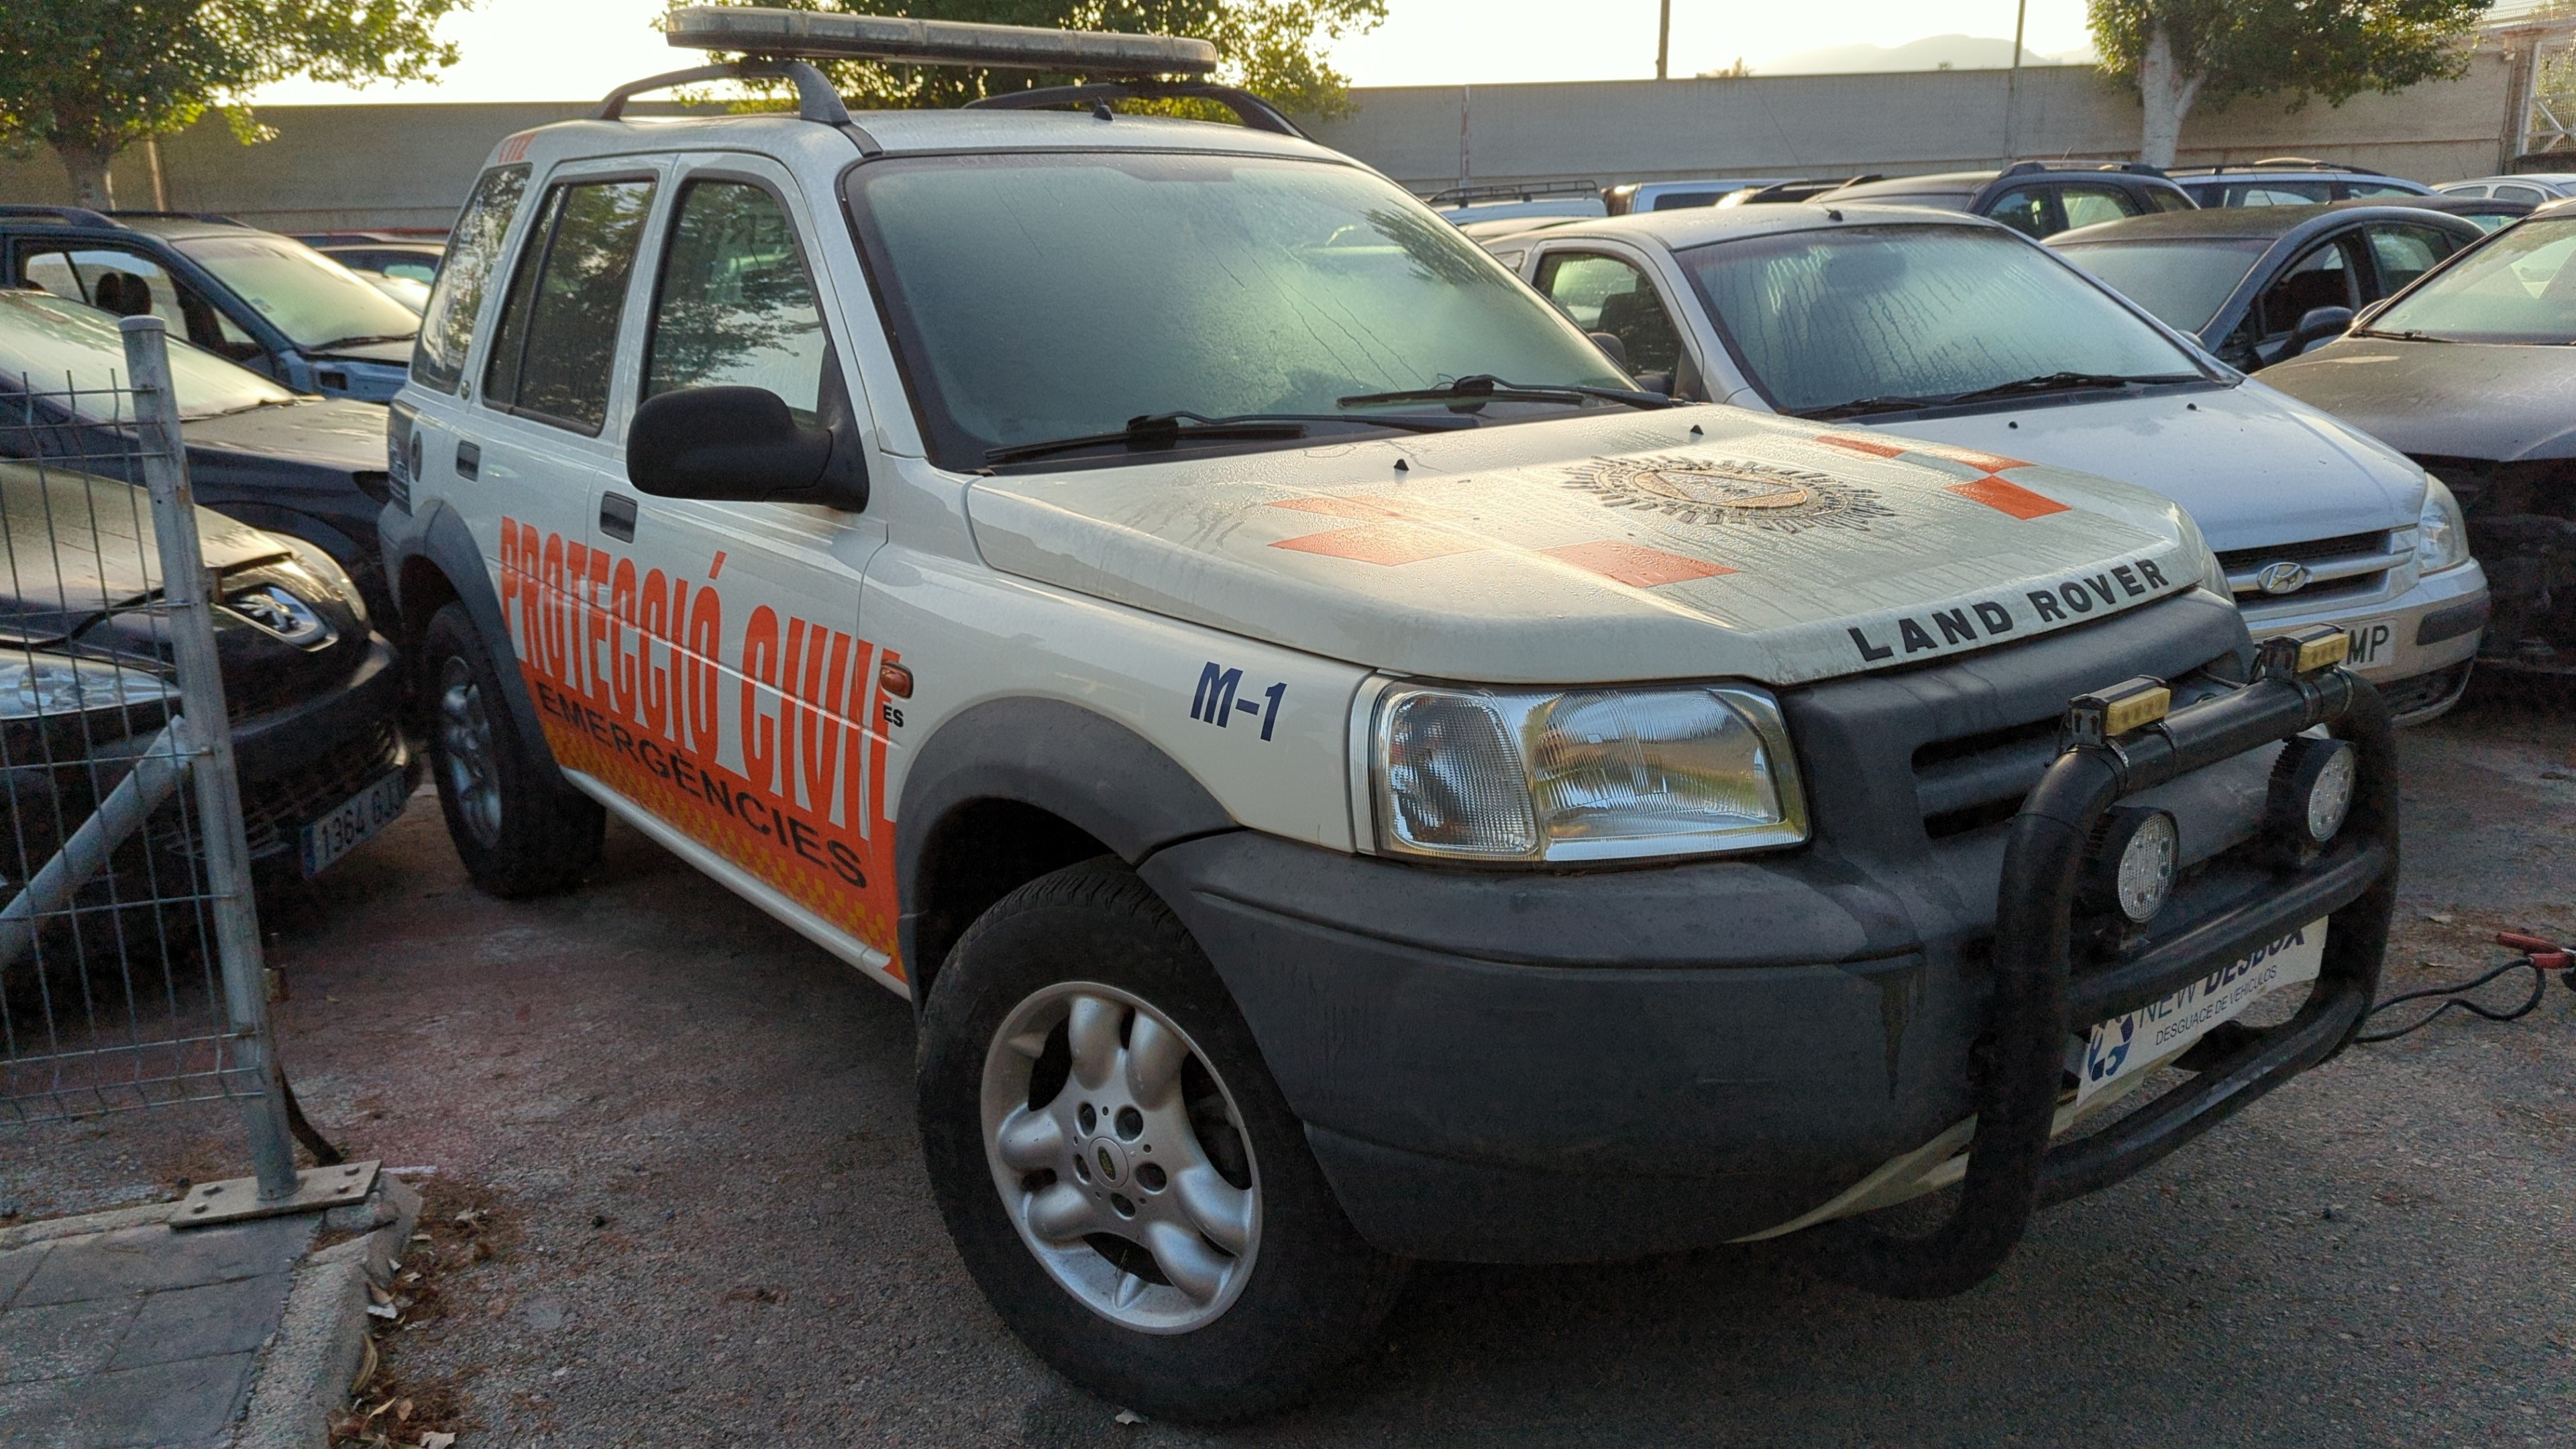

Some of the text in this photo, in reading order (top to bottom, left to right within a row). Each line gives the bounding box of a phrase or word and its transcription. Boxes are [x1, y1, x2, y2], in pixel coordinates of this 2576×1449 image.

[500, 516, 727, 761] PROTECCIÓ
[1847, 559, 2169, 662] LAND ROVER
[883, 704, 904, 728] ES
[1190, 661, 1287, 742] M-1
[537, 682, 869, 889] EMERGÈNCIES
[322, 800, 366, 861] 1364
[2156, 1004, 2213, 1046] DESGUACE
[2215, 995, 2228, 1015] DE
